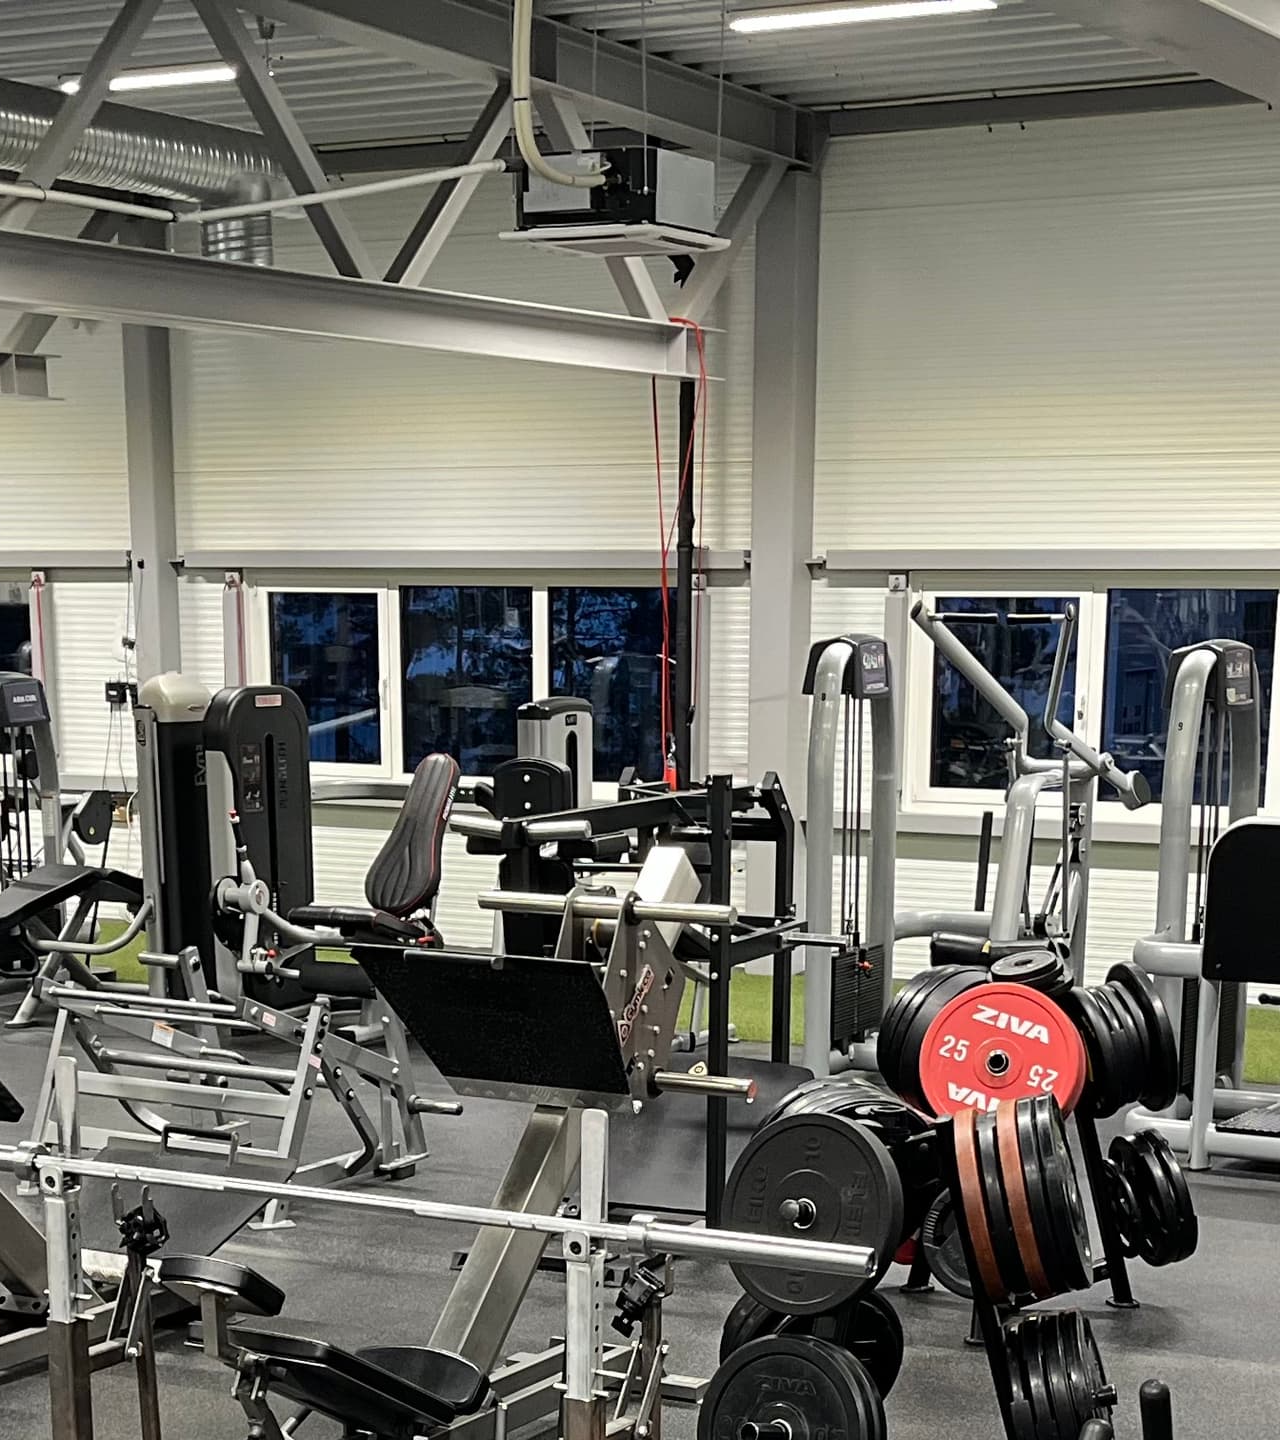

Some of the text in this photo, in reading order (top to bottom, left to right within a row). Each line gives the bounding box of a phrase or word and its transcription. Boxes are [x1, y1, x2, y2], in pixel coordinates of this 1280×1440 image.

[972, 1004, 1050, 1045] ZIVA
[939, 1035, 970, 1062] 25
[1027, 1064, 1059, 1092] 25
[947, 1082, 1001, 1113] IVA
